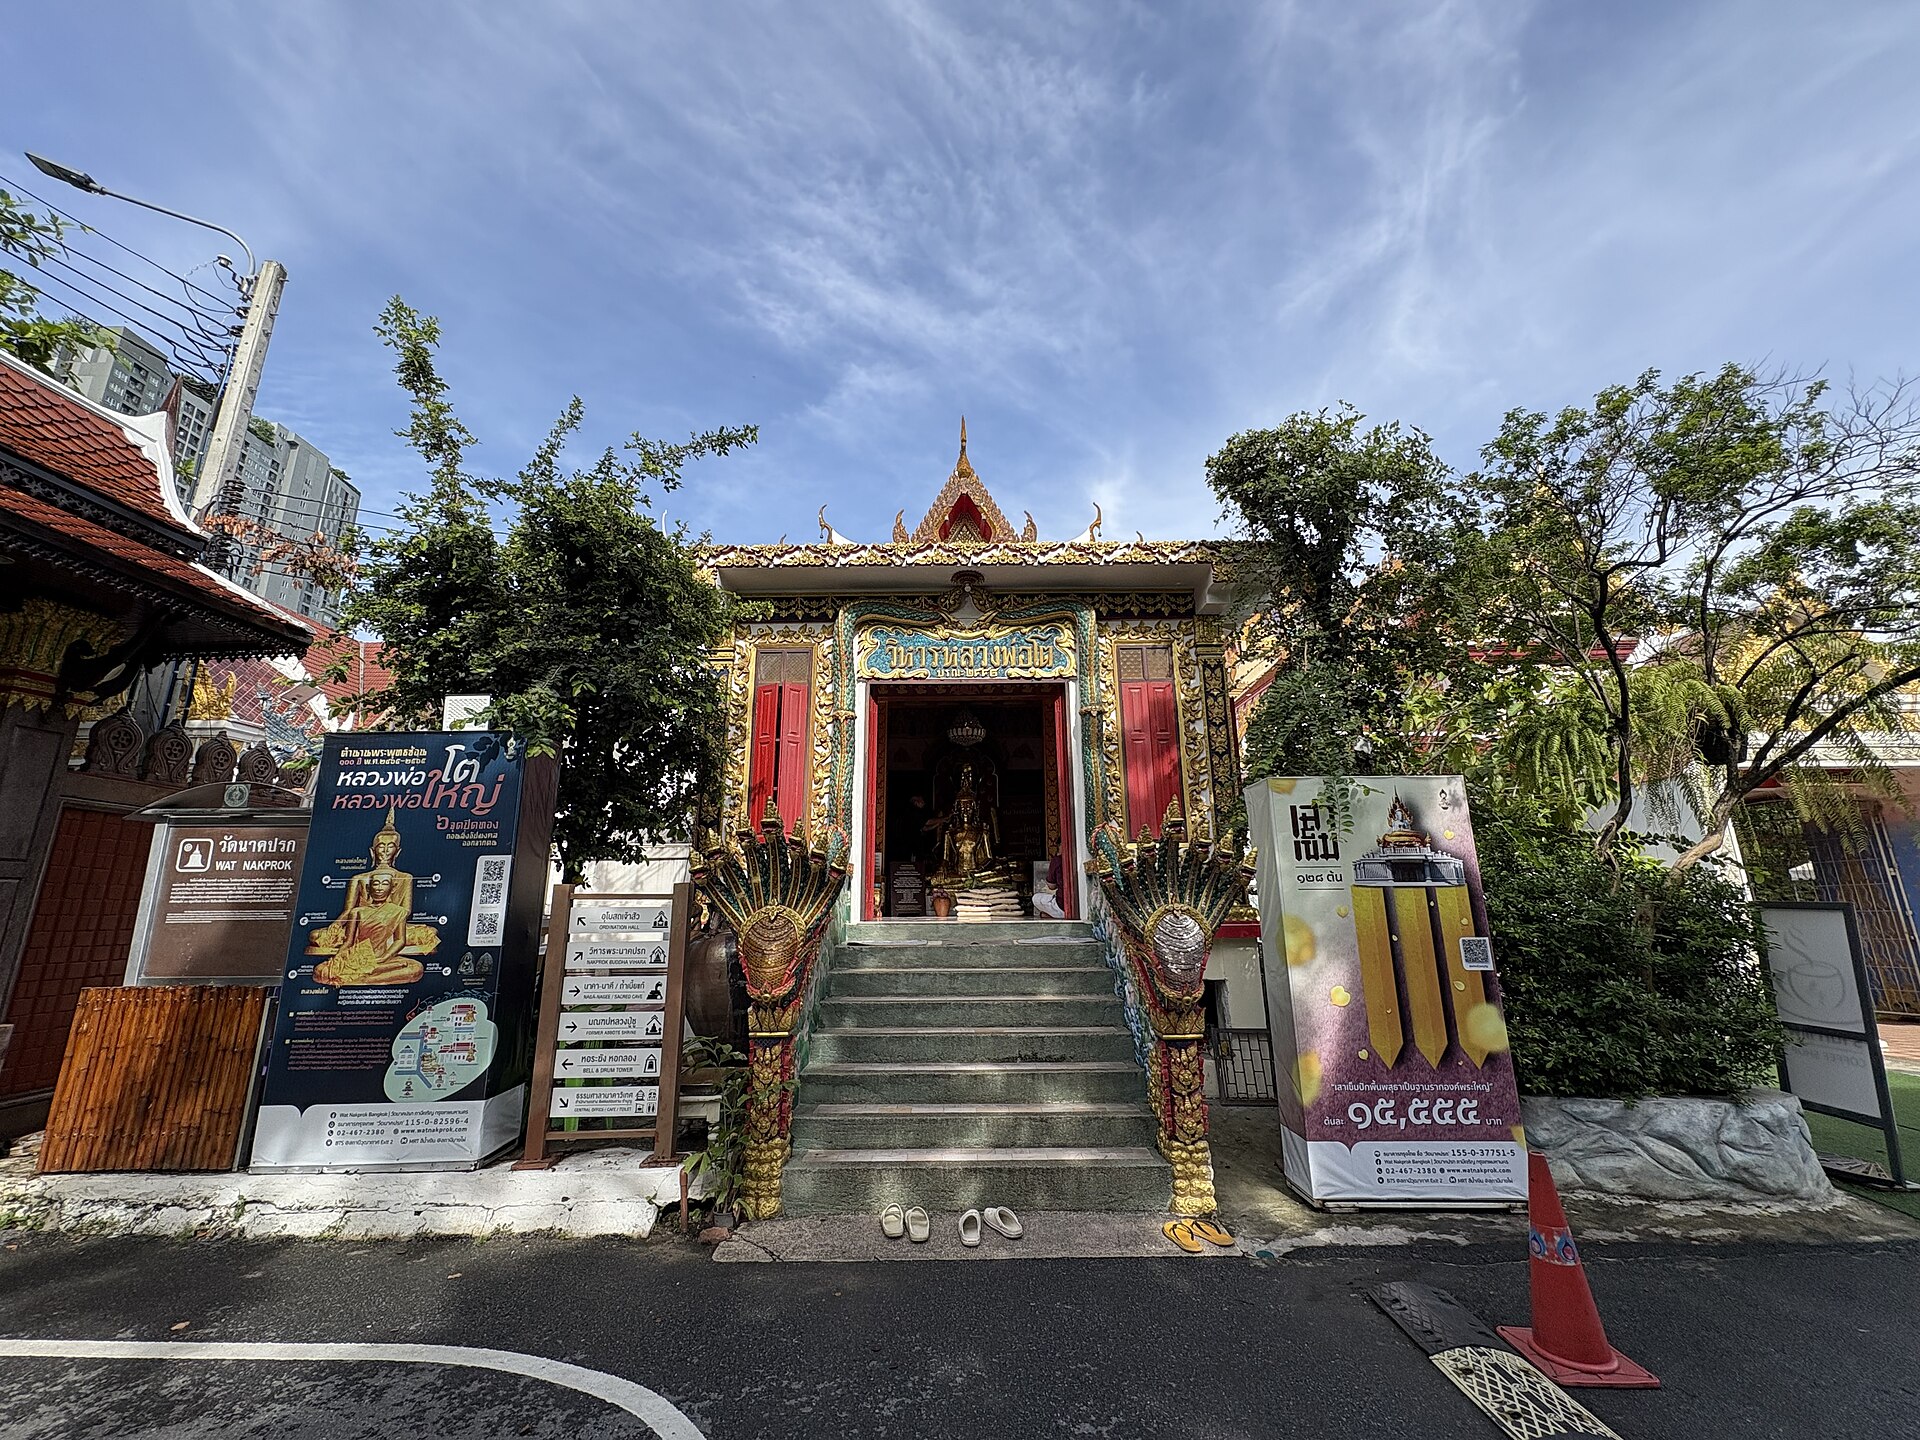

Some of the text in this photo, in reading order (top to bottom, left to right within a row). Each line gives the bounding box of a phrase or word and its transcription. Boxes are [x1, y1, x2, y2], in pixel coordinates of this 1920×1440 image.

[218, 835, 296, 853] วัดนาคปรก
[215, 860, 292, 871] WAT NAKPROK
[1297, 870, 1343, 884] ๑๒๘ ต้น
[589, 947, 646, 955] วิหารพระนาคปรก
[608, 1054, 637, 1063] หอกลอง
[1323, 1097, 1502, 1130] ต้นละ ๑๕,๕๕๕ บาท
[405, 1117, 469, 1126] 115-0-82596-4
[1451, 1149, 1515, 1157] 155-0-37751-5
